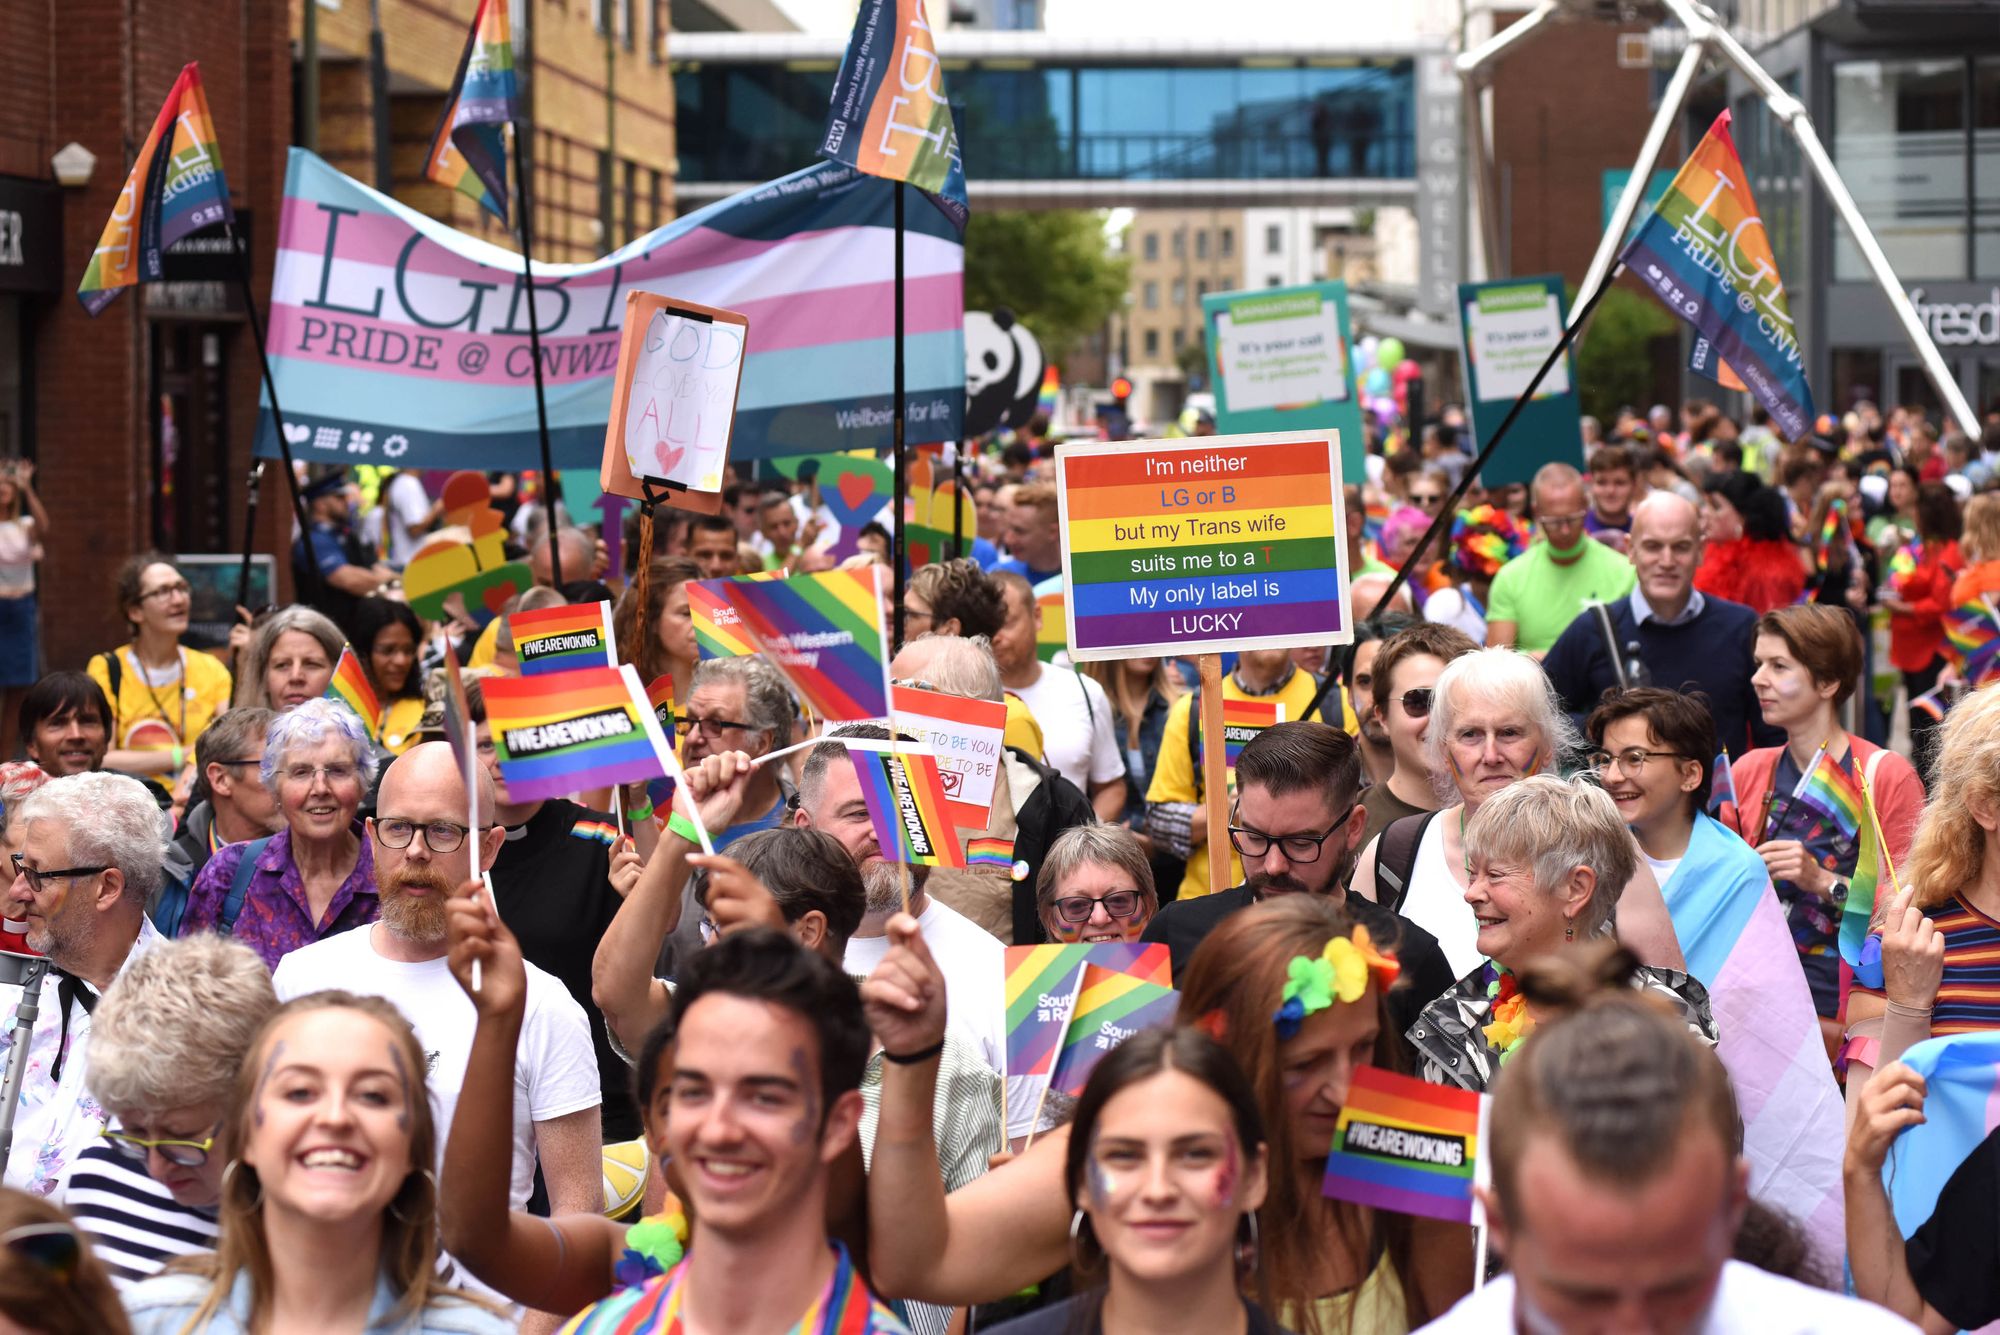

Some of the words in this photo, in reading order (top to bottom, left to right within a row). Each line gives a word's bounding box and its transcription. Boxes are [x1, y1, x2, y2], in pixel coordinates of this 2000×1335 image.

[1670, 223, 1738, 295] PRIDE
[1736, 291, 1756, 313] @
[297, 316, 443, 371] PRIDE
[457, 342, 490, 374] @
[646, 312, 741, 369] GOD
[636, 397, 719, 452] ALL
[908, 402, 929, 423] for
[930, 399, 950, 420] life
[1146, 457, 1174, 476] I'm
[1180, 454, 1248, 474] neither
[1161, 488, 1190, 507] LG
[1196, 490, 1216, 504] or
[1223, 486, 1236, 503] B
[1115, 522, 1145, 541] but
[1151, 523, 1180, 541] my
[1186, 518, 1241, 537] Trans
[1247, 514, 1286, 532] wife
[1131, 553, 1176, 573] suits
[1182, 554, 1213, 569] me
[1218, 551, 1237, 568] to
[1243, 551, 1255, 567] a
[1261, 546, 1274, 565] T
[1129, 587, 1159, 608] My
[1165, 583, 1205, 606] only
[1211, 579, 1257, 601] label
[1263, 580, 1280, 597] is
[1170, 612, 1243, 635] LUCKY
[524, 633, 597, 656] #WEAREWOKING
[791, 630, 855, 650] Western
[505, 711, 633, 753] #WEAREWOKING
[931, 731, 949, 746] TO
[951, 735, 969, 751] BE
[971, 739, 996, 758] YOU,
[956, 757, 974, 773] TO
[976, 762, 994, 778] BE
[1346, 1121, 1464, 1167] #WEAREWOKING
